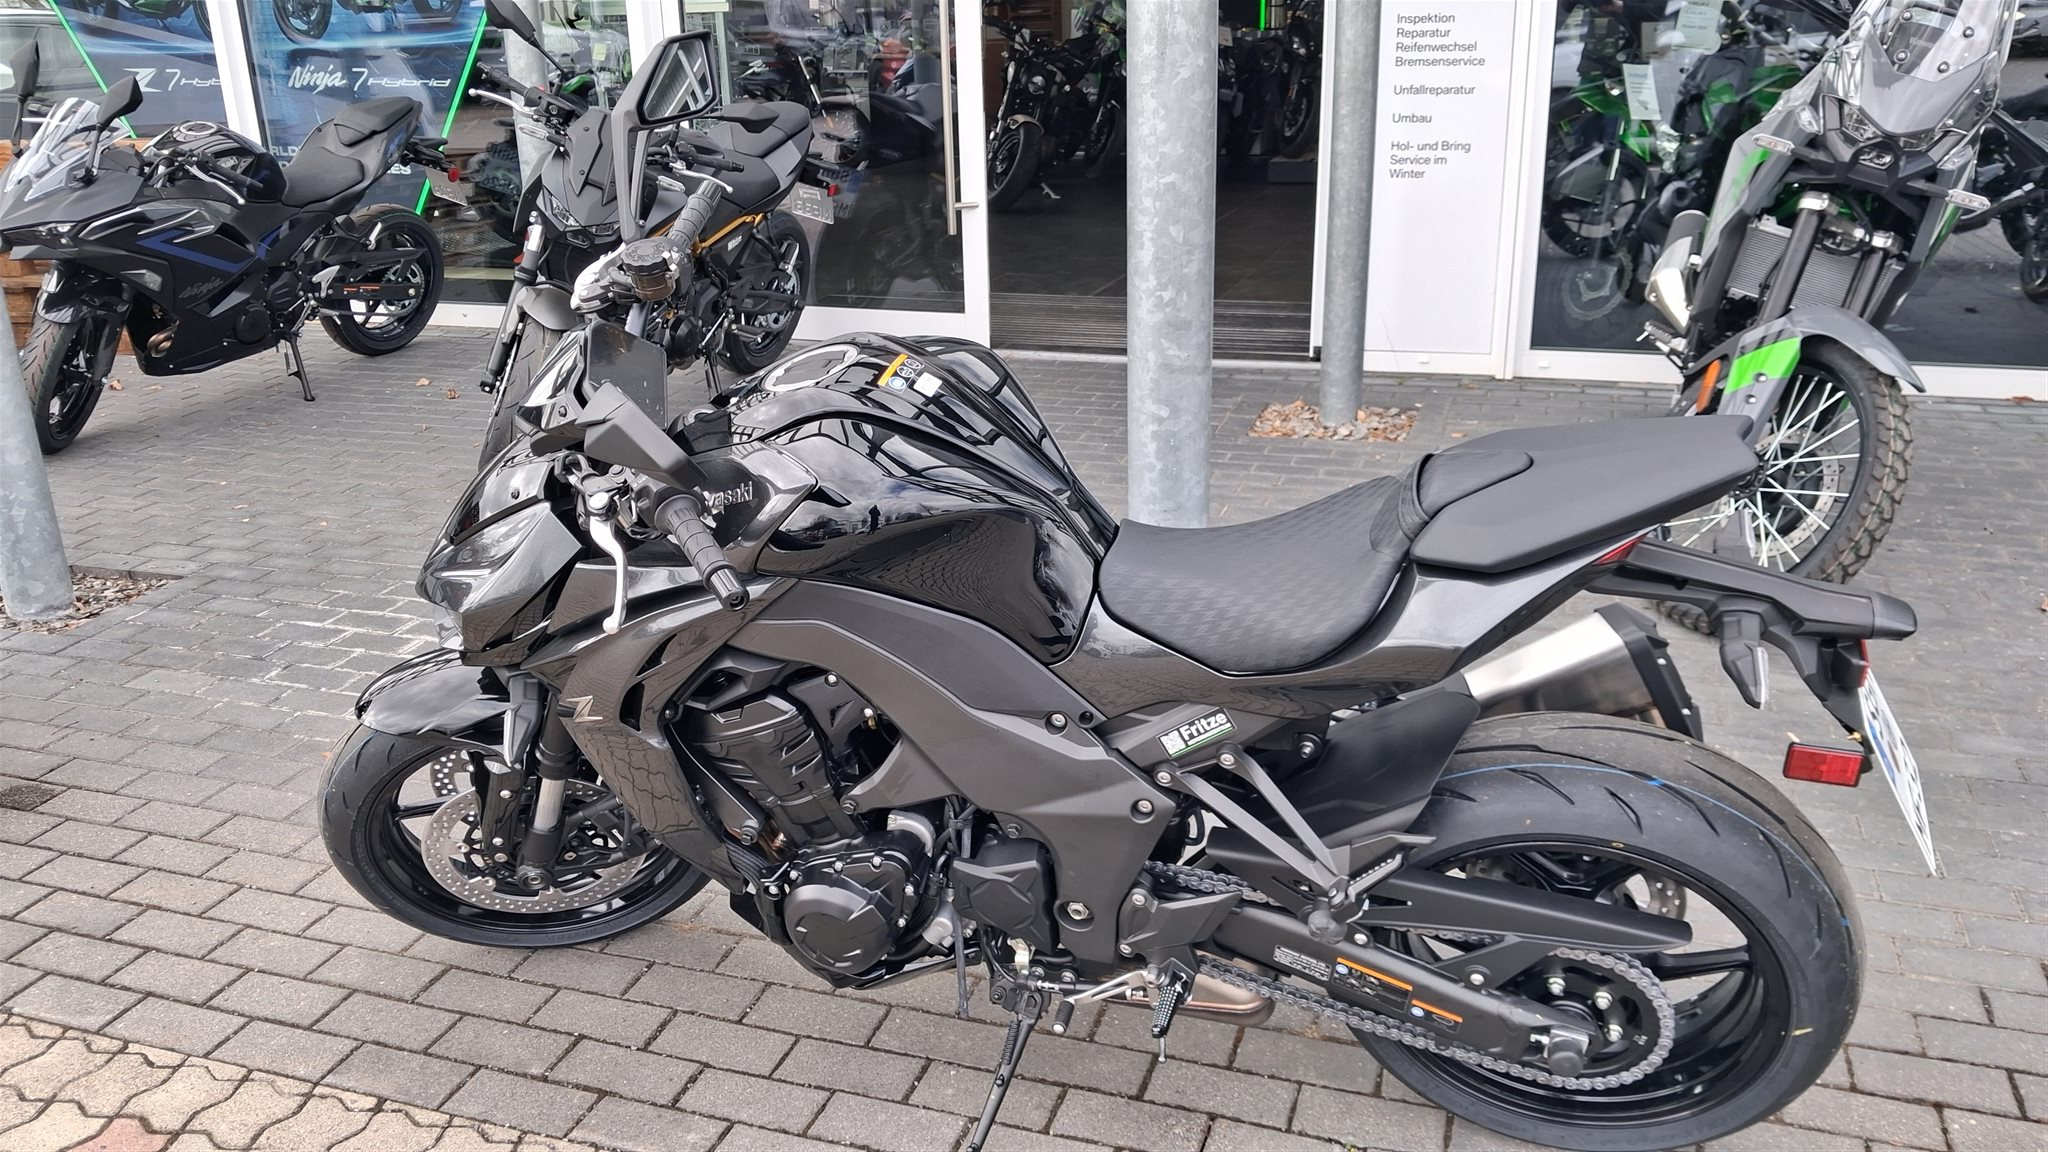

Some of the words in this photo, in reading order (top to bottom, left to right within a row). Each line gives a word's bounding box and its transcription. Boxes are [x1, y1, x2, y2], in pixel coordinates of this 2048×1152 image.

[1397, 12, 1456, 26] Inspektion
[1396, 27, 1451, 40] Reparatur
[1395, 41, 1478, 53] Reifenwechsel
[1395, 56, 1486, 67] Bremsenservice
[165, 68, 181, 92] 7
[287, 64, 347, 95] Ninja
[351, 67, 369, 92] 7
[367, 77, 451, 88] Hybrid
[1393, 84, 1476, 97] Unfallreparatur
[1392, 113, 1433, 124] Umbau
[1390, 140, 1414, 152] Hol-
[1416, 140, 1439, 152] und
[1440, 140, 1472, 154] Bring
[1389, 154, 1432, 166] Service
[1433, 154, 1448, 166] im
[1389, 168, 1426, 179] Winter
[1179, 712, 1228, 742] Fritze
